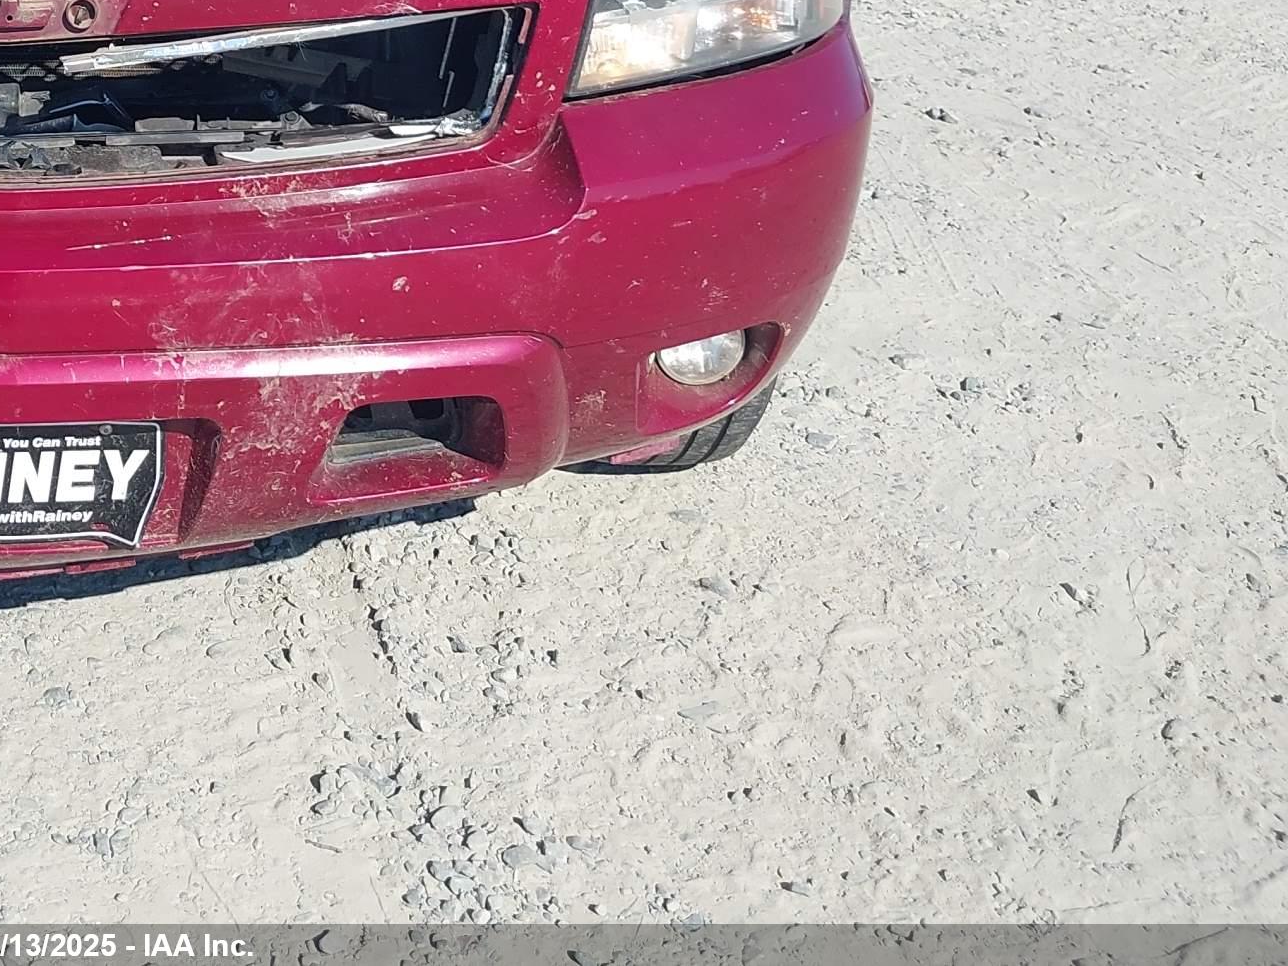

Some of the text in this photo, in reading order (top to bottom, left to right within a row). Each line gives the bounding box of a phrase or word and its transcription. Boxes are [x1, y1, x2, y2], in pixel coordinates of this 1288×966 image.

[3, 437, 29, 449] You
[32, 437, 61, 448] Can
[64, 436, 101, 448] Trust
